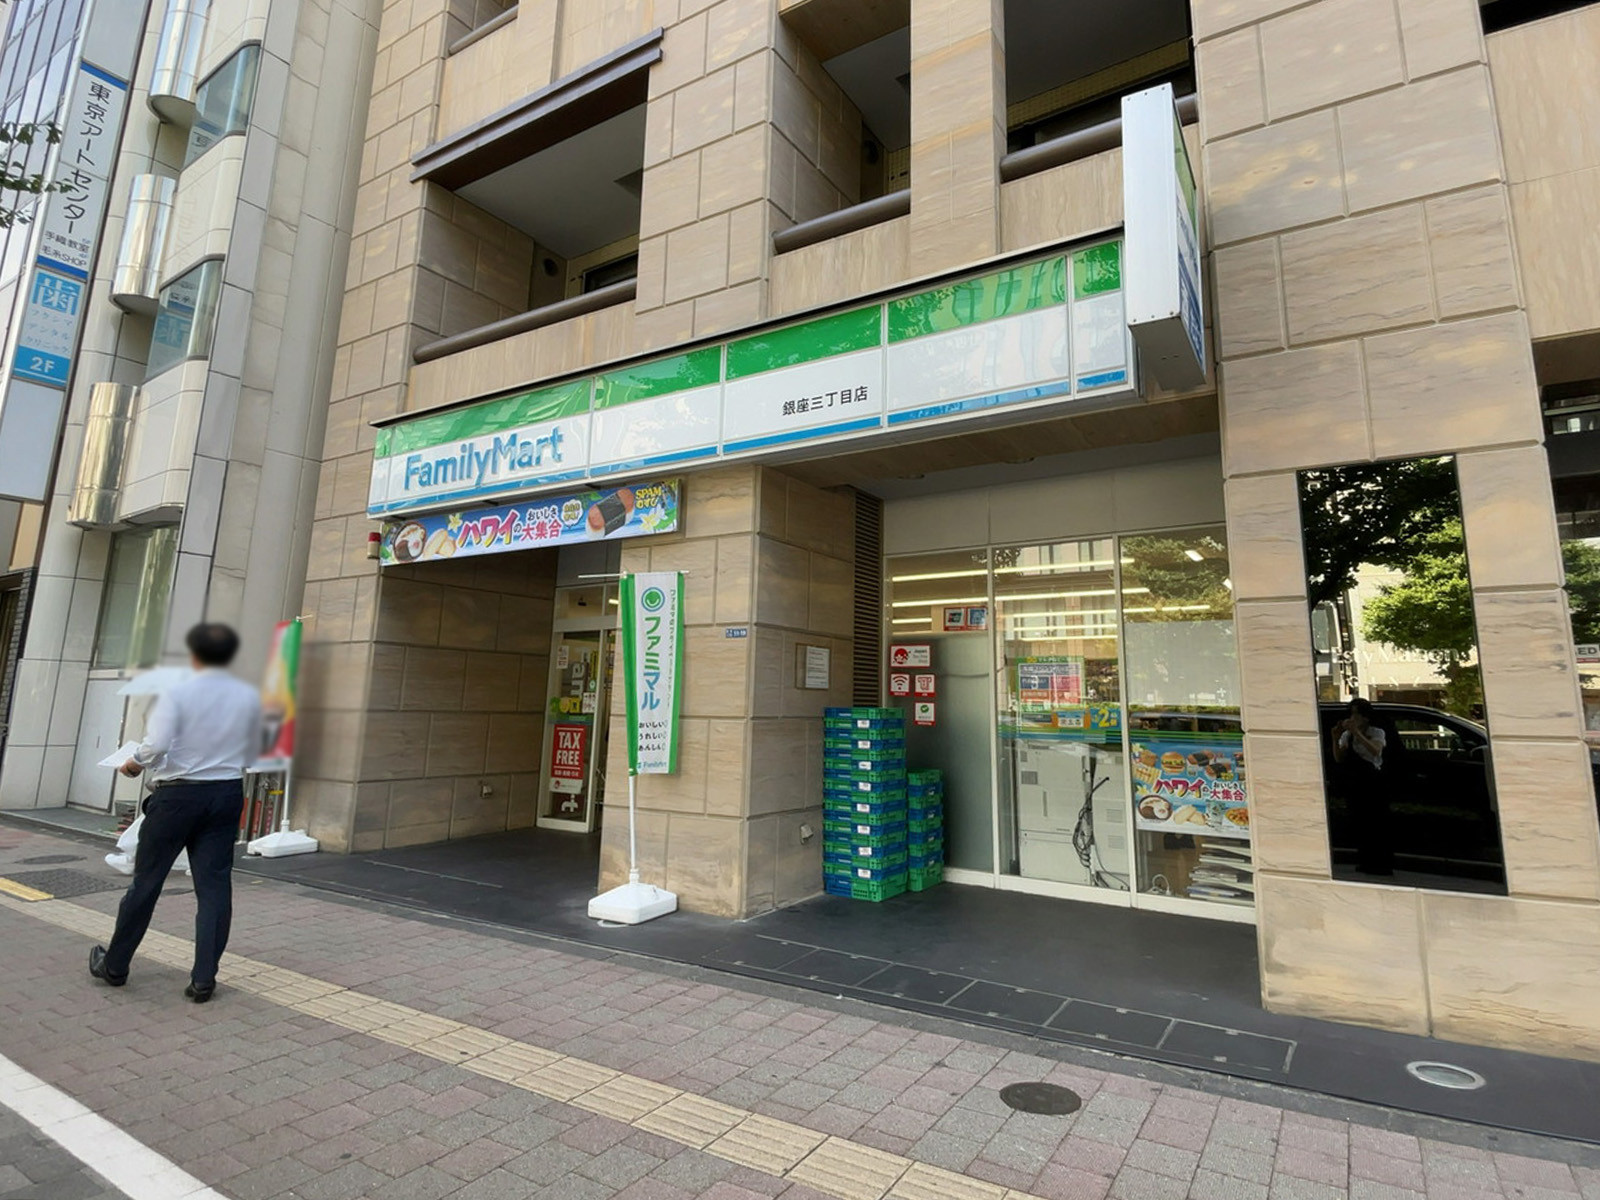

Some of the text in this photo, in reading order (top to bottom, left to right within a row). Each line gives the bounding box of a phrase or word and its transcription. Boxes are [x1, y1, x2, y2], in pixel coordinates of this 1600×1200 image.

[63, 81, 112, 234] 東京アートセンター
[30, 356, 55, 373] 2F
[782, 386, 868, 416] 銀座三丁目店
[404, 426, 564, 490] FamilyMart
[458, 509, 522, 548] ハワイの
[521, 519, 562, 541] 大集合
[1575, 646, 1598, 656] ED
[641, 615, 661, 711] ファミマル
[1346, 675, 1449, 688] GINZ
[558, 731, 581, 749] TAX
[555, 749, 580, 765] FREE
[1153, 779, 1209, 798] ハワイの
[1210, 789, 1245, 801] 大集合
